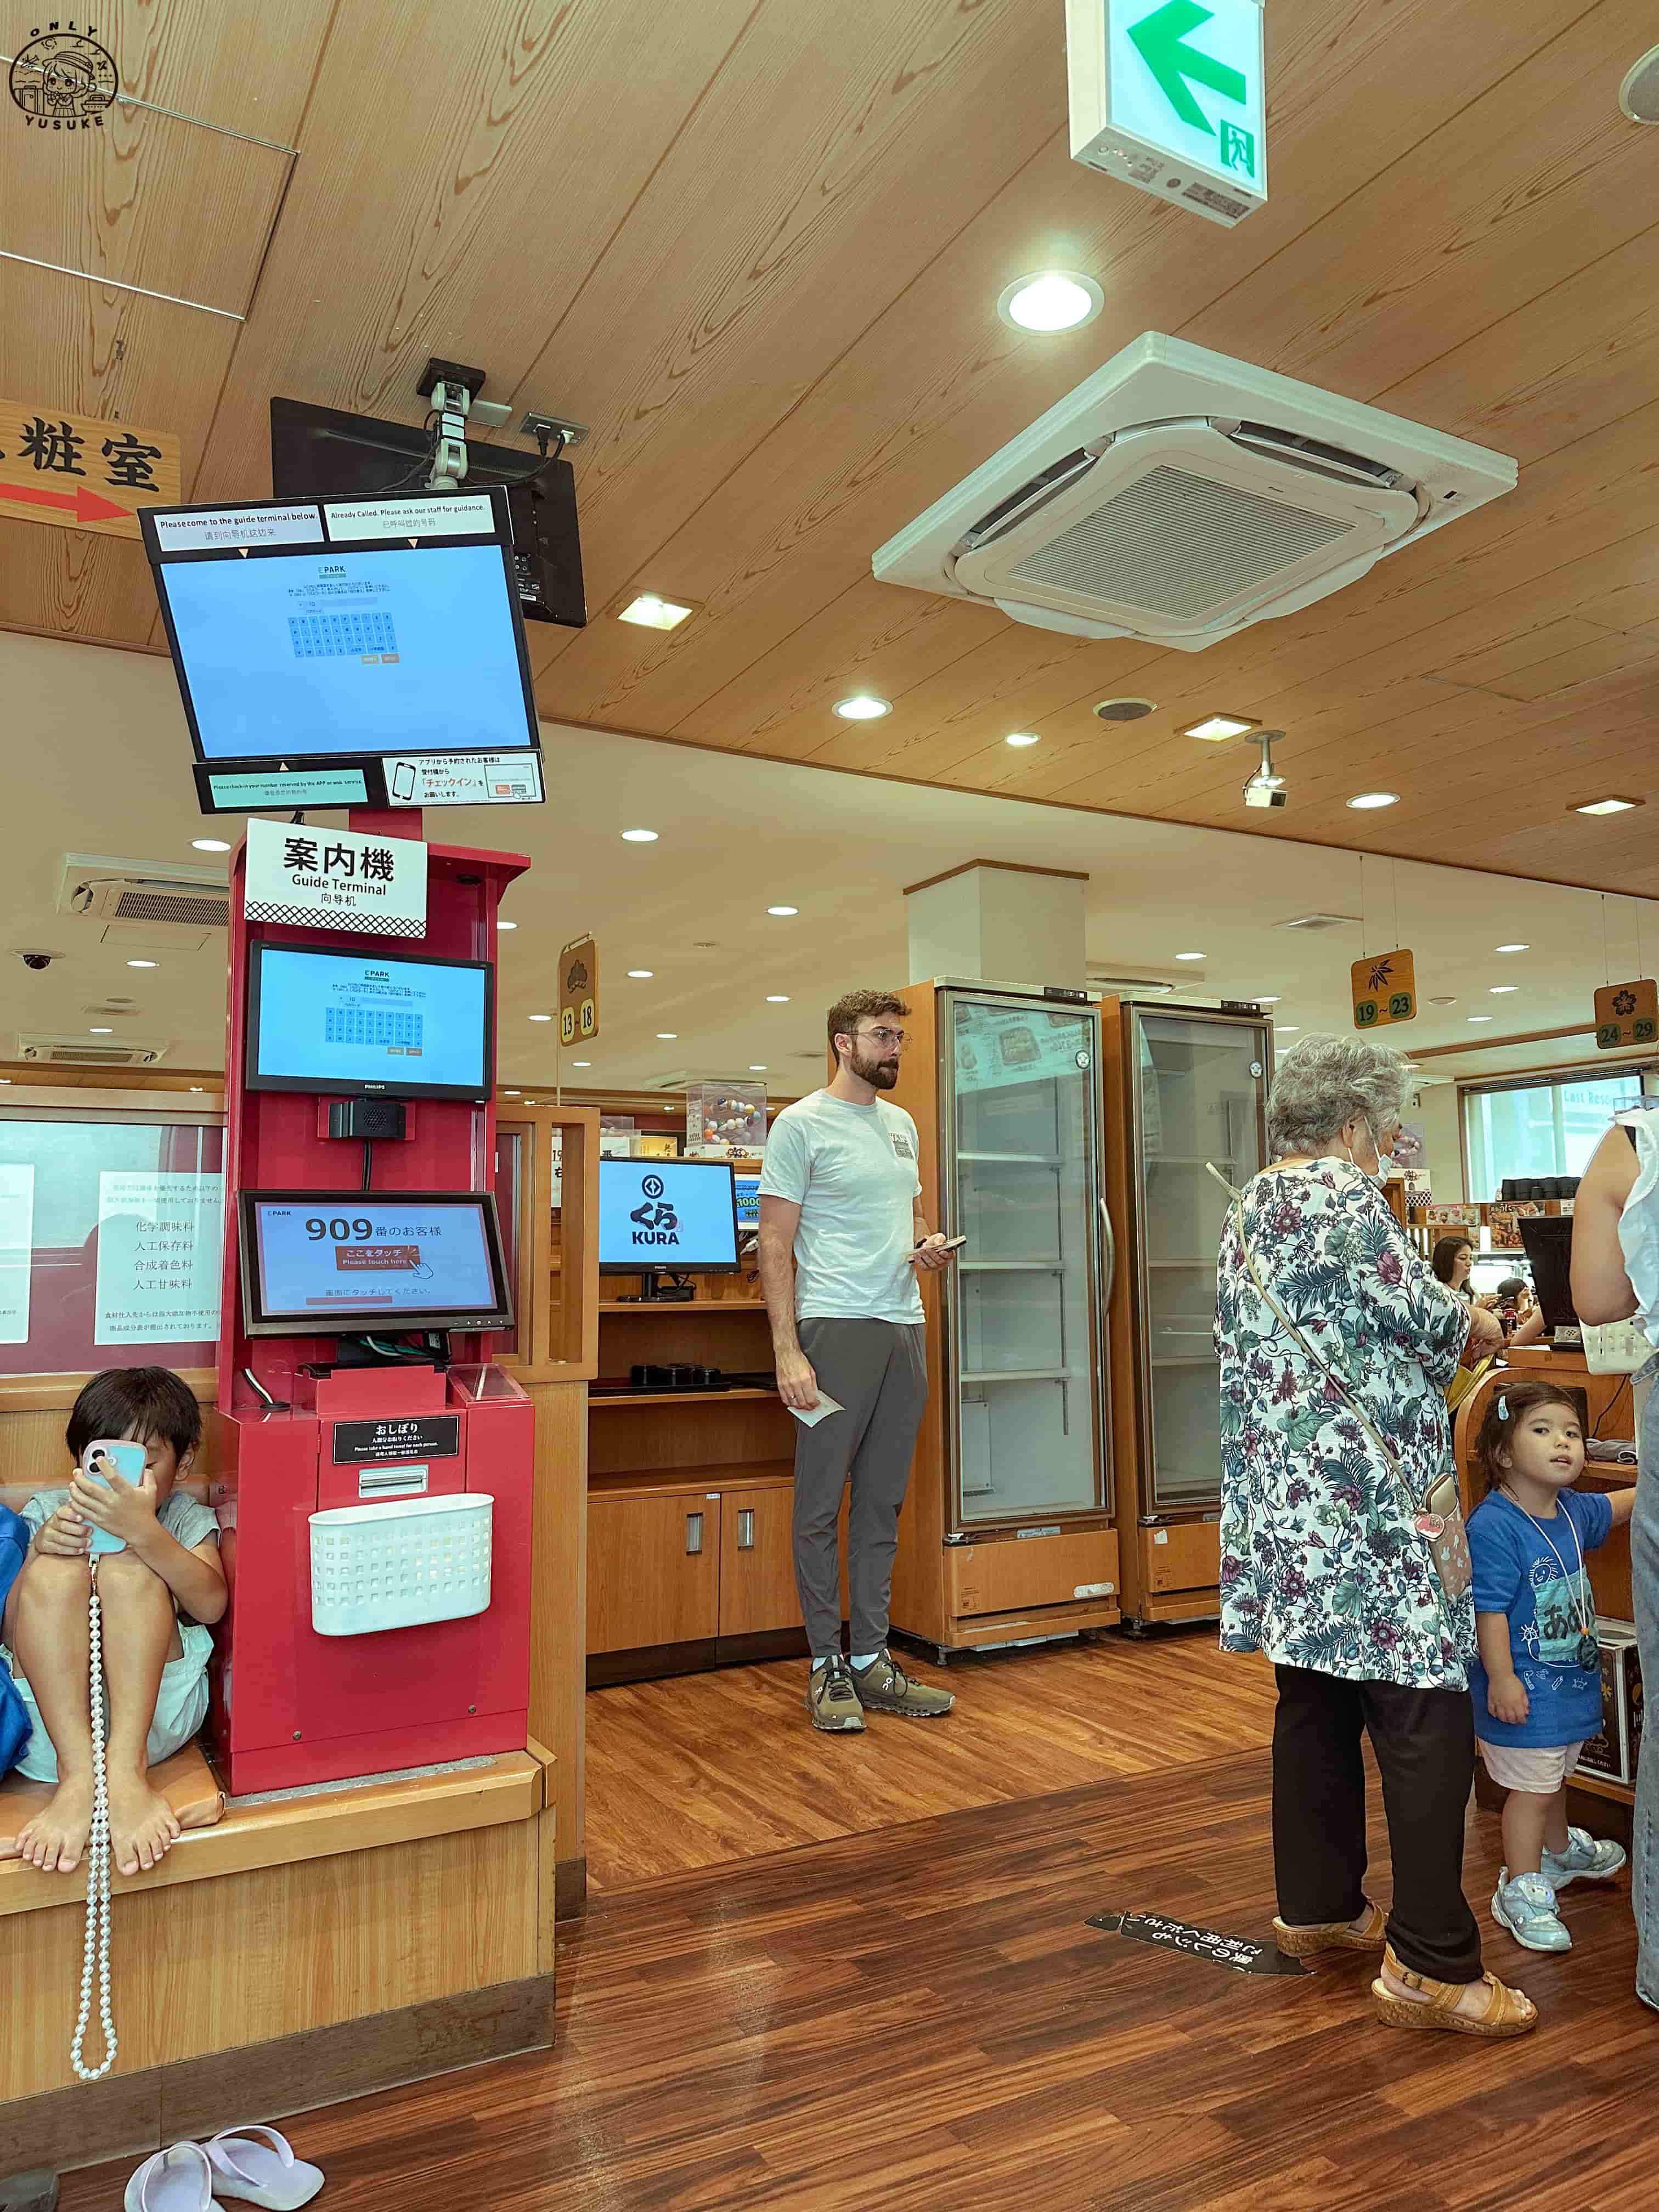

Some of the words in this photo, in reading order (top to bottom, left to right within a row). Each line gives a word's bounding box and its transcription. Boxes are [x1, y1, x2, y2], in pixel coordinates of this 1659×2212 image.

[0, 416, 162, 492] 粧室
[234, 516, 256, 526] guide
[257, 514, 290, 522] terminal
[331, 511, 356, 520] Already
[419, 757, 500, 765] アプリから予約されたお客様は
[283, 837, 394, 882] 案内機
[292, 873, 329, 889] Guide
[331, 878, 386, 896] Terminal
[321, 893, 357, 907] 向导机
[1359, 1004, 1374, 1022] 19
[1392, 996, 1409, 1014] 23
[563, 1013, 572, 1036] 13
[583, 1005, 592, 1029] 18
[1601, 1027, 1618, 1042] 24
[1635, 1022, 1652, 1037] 29
[630, 1201, 678, 1230] くら
[136, 1220, 194, 1233] 化学調味料
[631, 1231, 680, 1245] KURA
[134, 1239, 194, 1251] 人工保存料
[346, 1249, 403, 1257] ここをタッチ
[134, 1259, 193, 1271] 合成着色料
[133, 1278, 193, 1290] 人工甘味料
[375, 1423, 418, 1436] おしぼり
